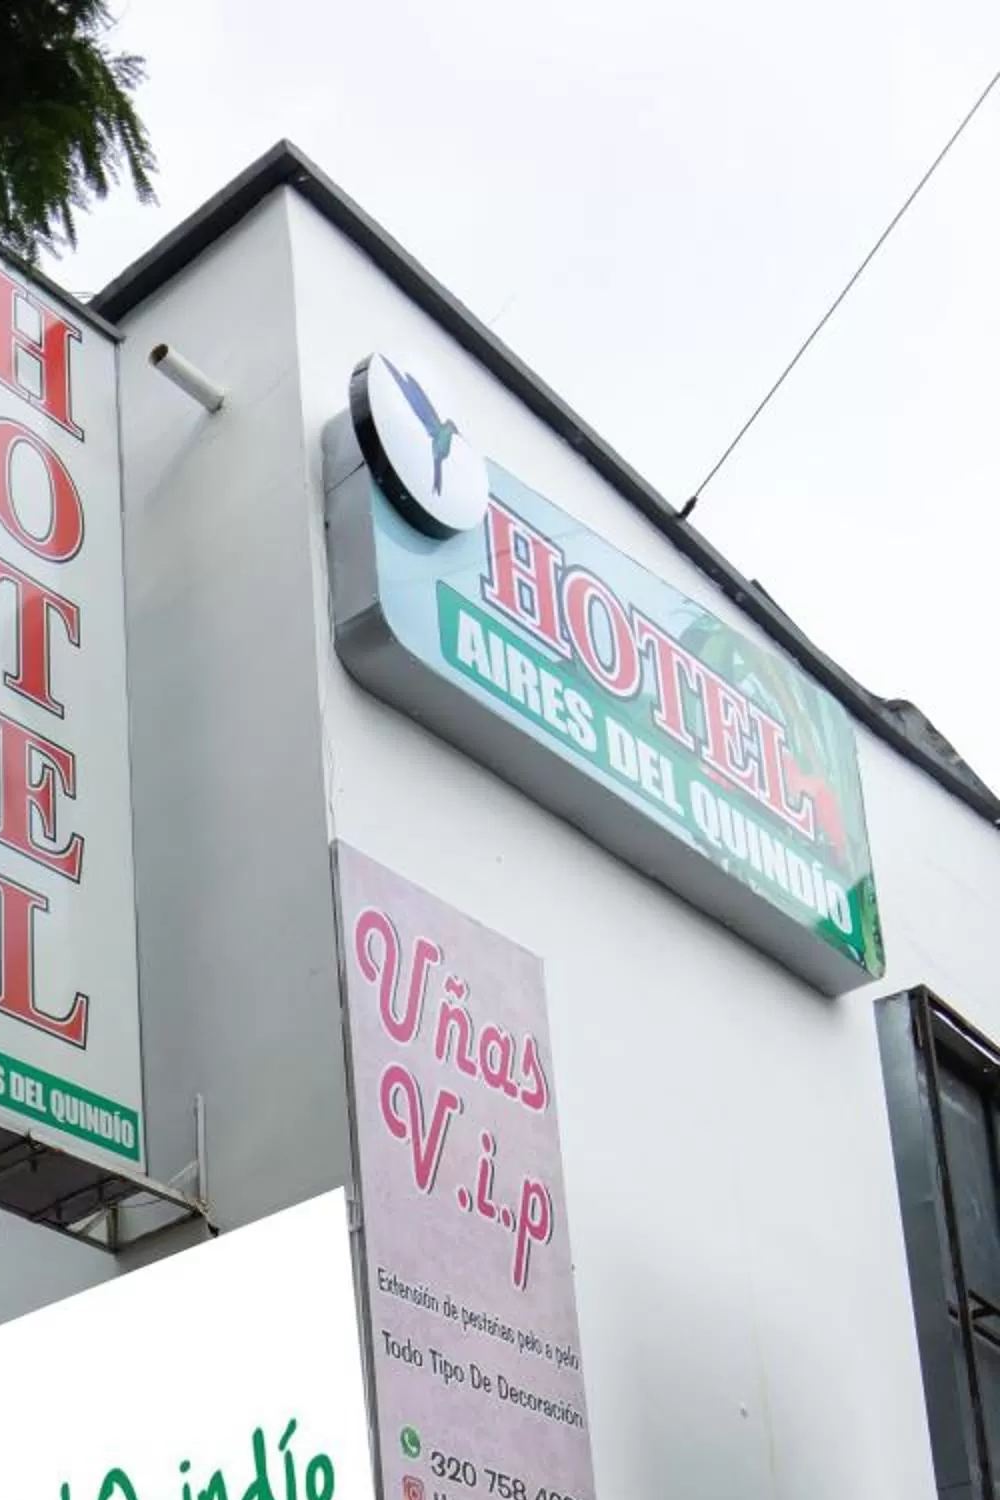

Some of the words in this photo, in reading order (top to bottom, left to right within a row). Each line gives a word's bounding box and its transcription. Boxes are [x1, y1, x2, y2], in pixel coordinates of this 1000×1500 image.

[478, 494, 817, 842] HOTEL
[457, 608, 597, 753] AIRES
[607, 716, 684, 818] DEL
[690, 779, 854, 935] QUINDÍO
[354, 906, 550, 1112] Uñas
[10, 1069, 47, 1113] DEL
[51, 1088, 136, 1149] QUINDÍO
[379, 1062, 554, 1293] V.i.p
[381, 1329, 424, 1368] Todo
[429, 1347, 466, 1385] Tipo
[470, 1363, 493, 1394] De
[497, 1374, 585, 1430] Decoración
[443, 1294, 459, 1321] de
[462, 1305, 516, 1346] pestañas
[517, 1329, 543, 1356] pelo
[430, 1451, 478, 1488] 320
